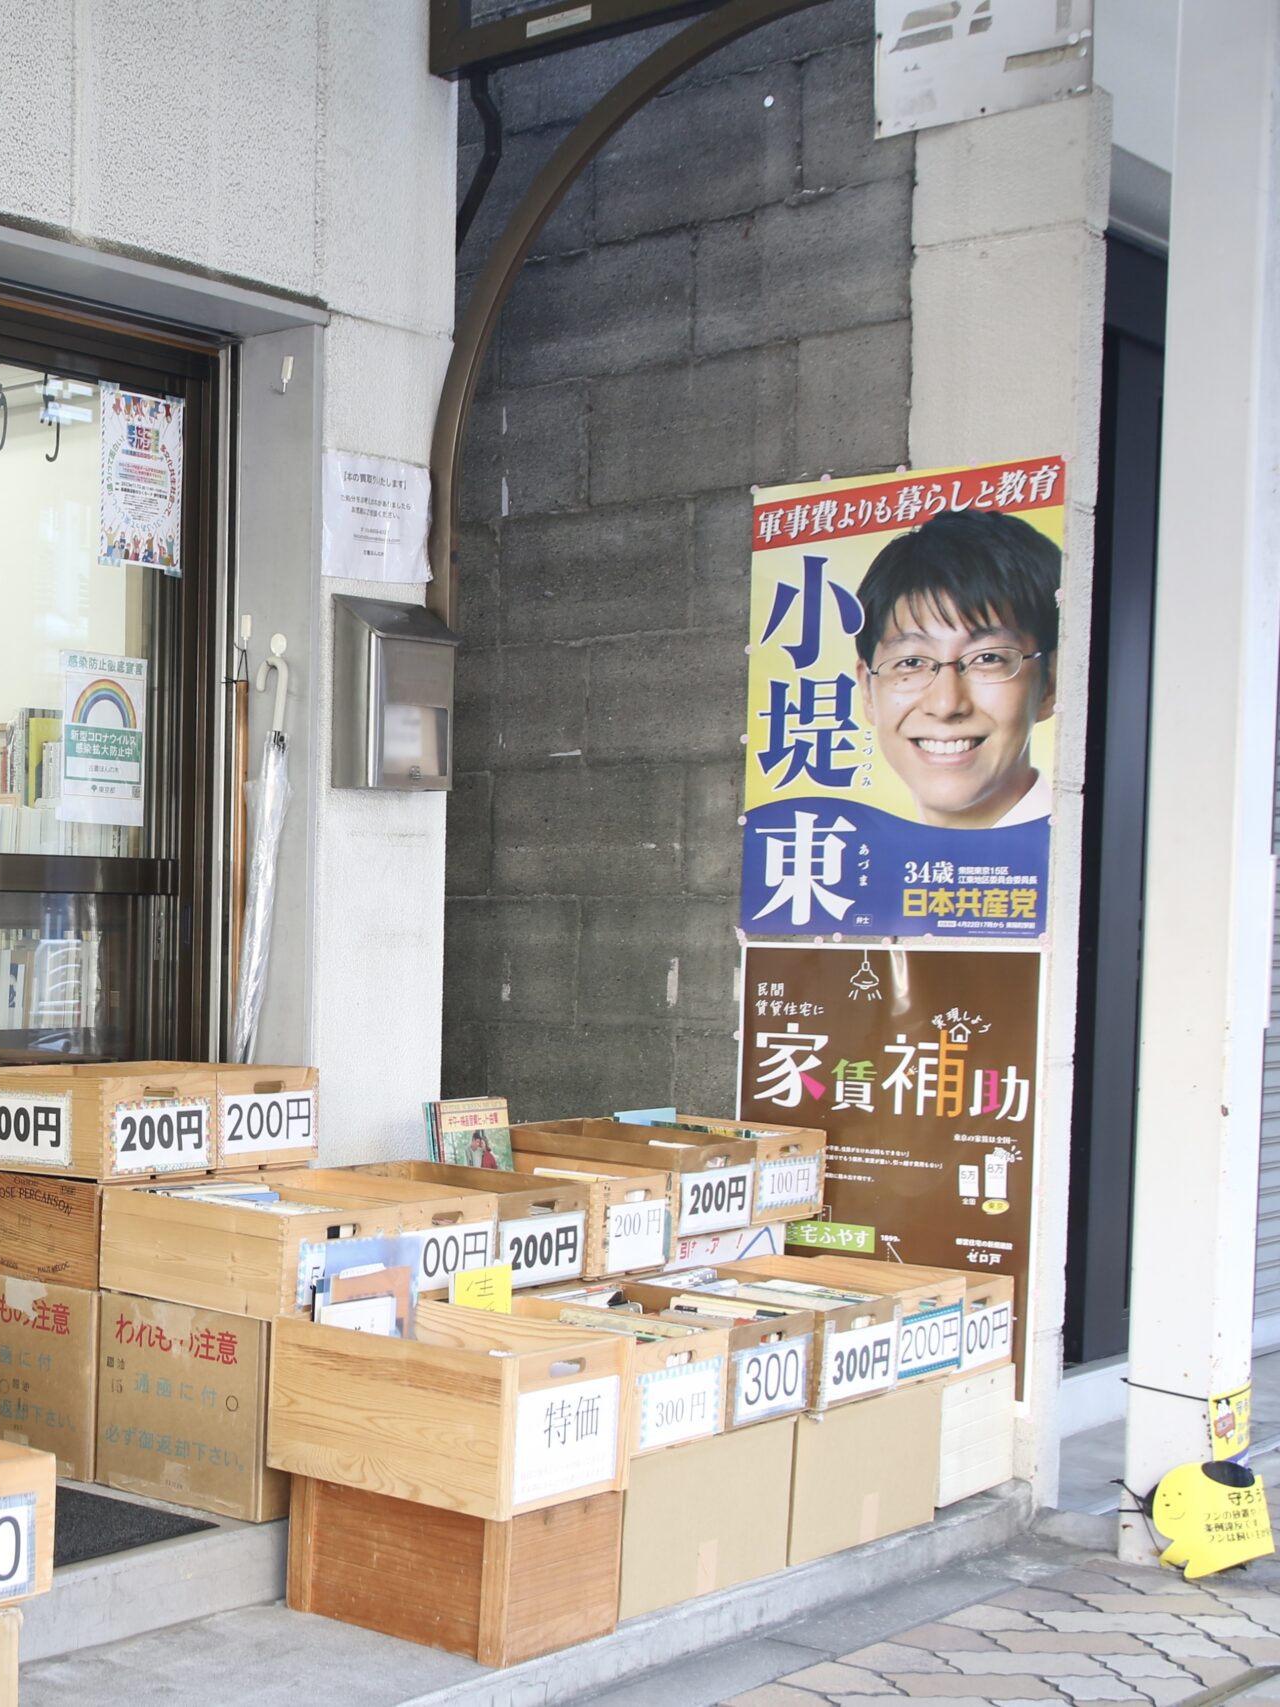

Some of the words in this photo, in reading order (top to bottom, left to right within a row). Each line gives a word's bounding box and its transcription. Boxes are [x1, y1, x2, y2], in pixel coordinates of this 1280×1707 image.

[757, 464, 1061, 543] 軍事費よりも暮らしと教育
[67, 655, 144, 676] 感染防止徹底宣言
[70, 729, 137, 746] 新型コロナウイルス
[75, 743, 133, 758] 感染拡大防止中
[858, 844, 871, 887] あづま
[903, 861, 955, 885] 34歳
[902, 888, 1038, 918] 日本共産党
[757, 982, 785, 997] 民間
[756, 1001, 825, 1017] 賃貸住宅に
[754, 1023, 1030, 1122] 家賃補助
[120, 1109, 204, 1153] 200円
[227, 1097, 312, 1142] 200円
[769, 1168, 811, 1194] 100円
[960, 1170, 977, 1181] 5万
[987, 1163, 1005, 1175] 8万
[19, 1187, 73, 1216] PERGANSON
[689, 1173, 747, 1215] 200円
[509, 1225, 578, 1270] 200円
[901, 1316, 960, 1365] 200円
[744, 1350, 799, 1406] 300
[832, 1337, 891, 1385] 300円
[543, 1395, 601, 1448] 特価
